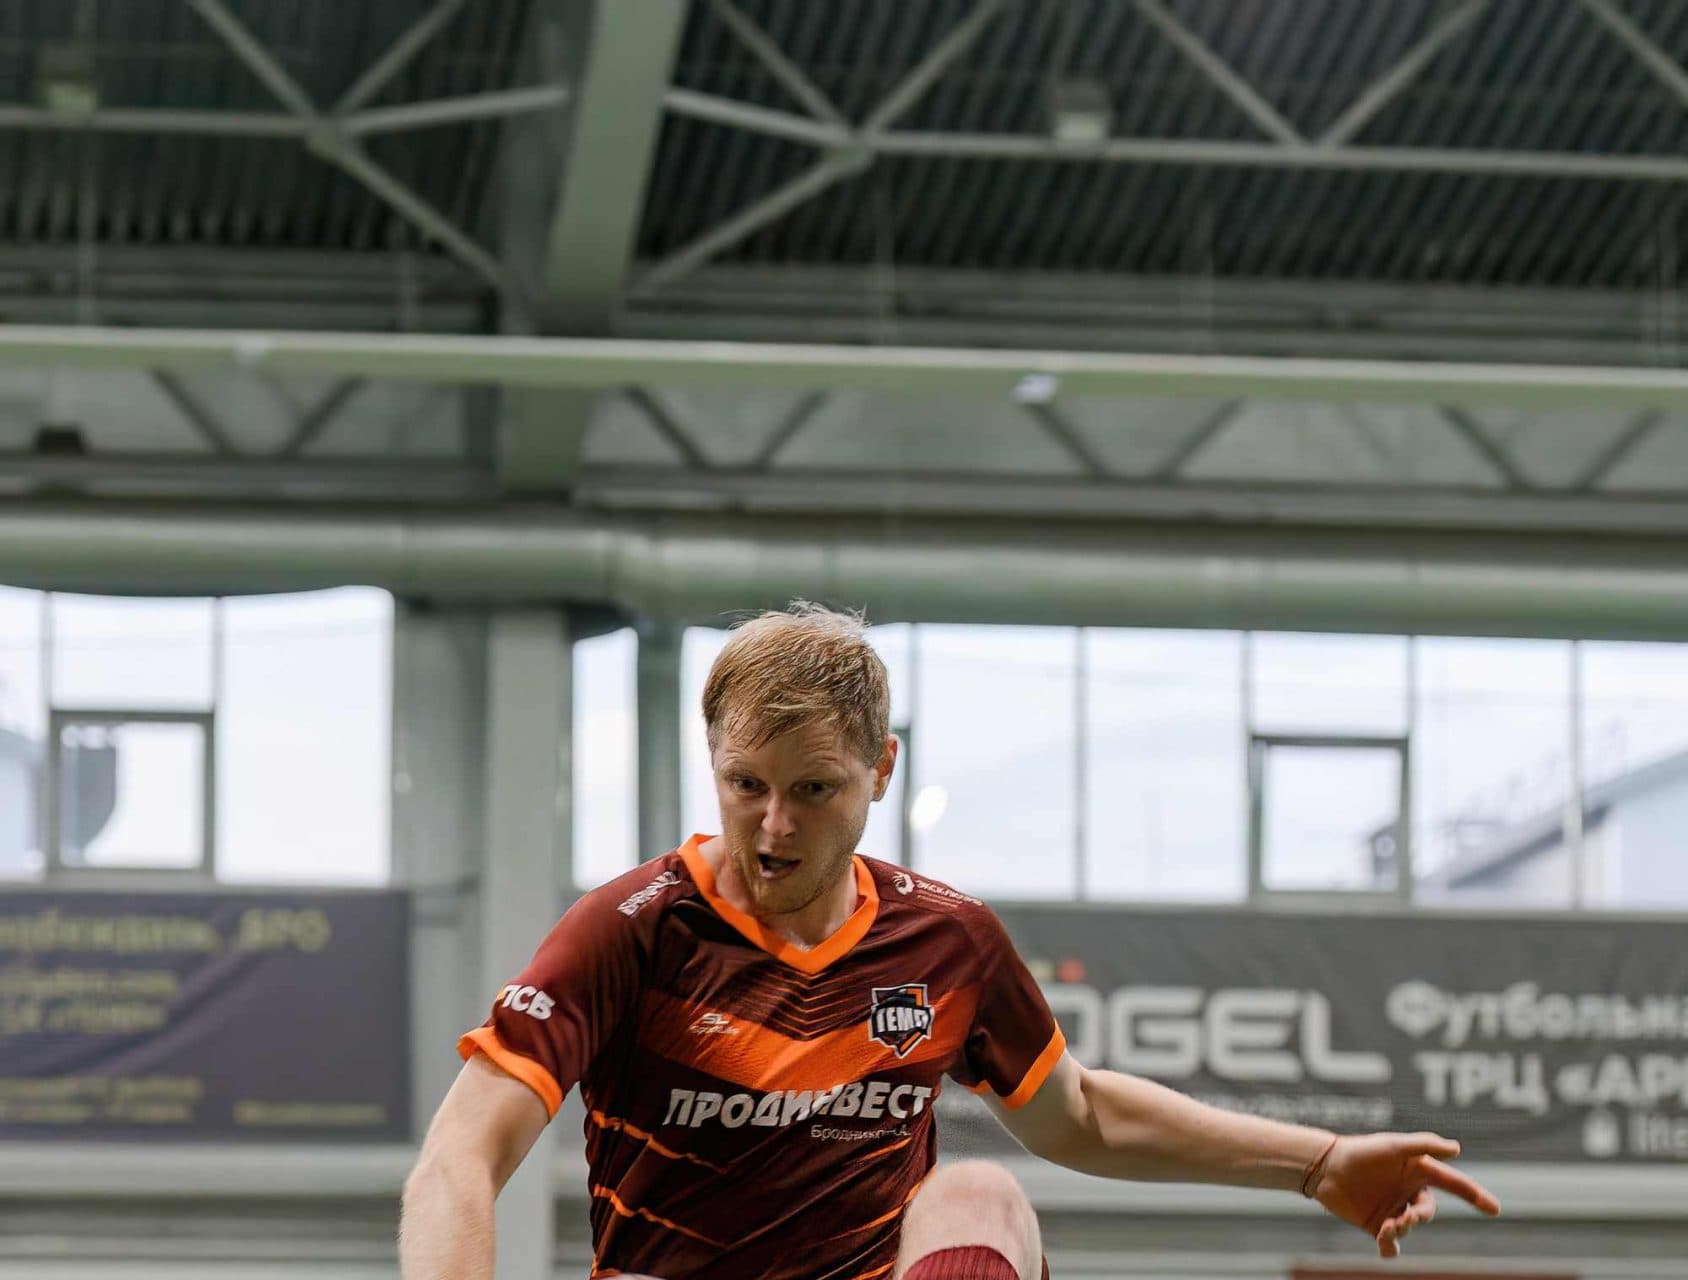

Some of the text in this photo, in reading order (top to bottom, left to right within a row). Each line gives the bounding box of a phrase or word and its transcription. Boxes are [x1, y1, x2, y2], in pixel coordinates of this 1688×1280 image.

[1387, 978, 1688, 1047] Футбольн
[661, 1081, 932, 1128] ПРОДИНВЕСТ
[1556, 1052, 1688, 1105] «АР
